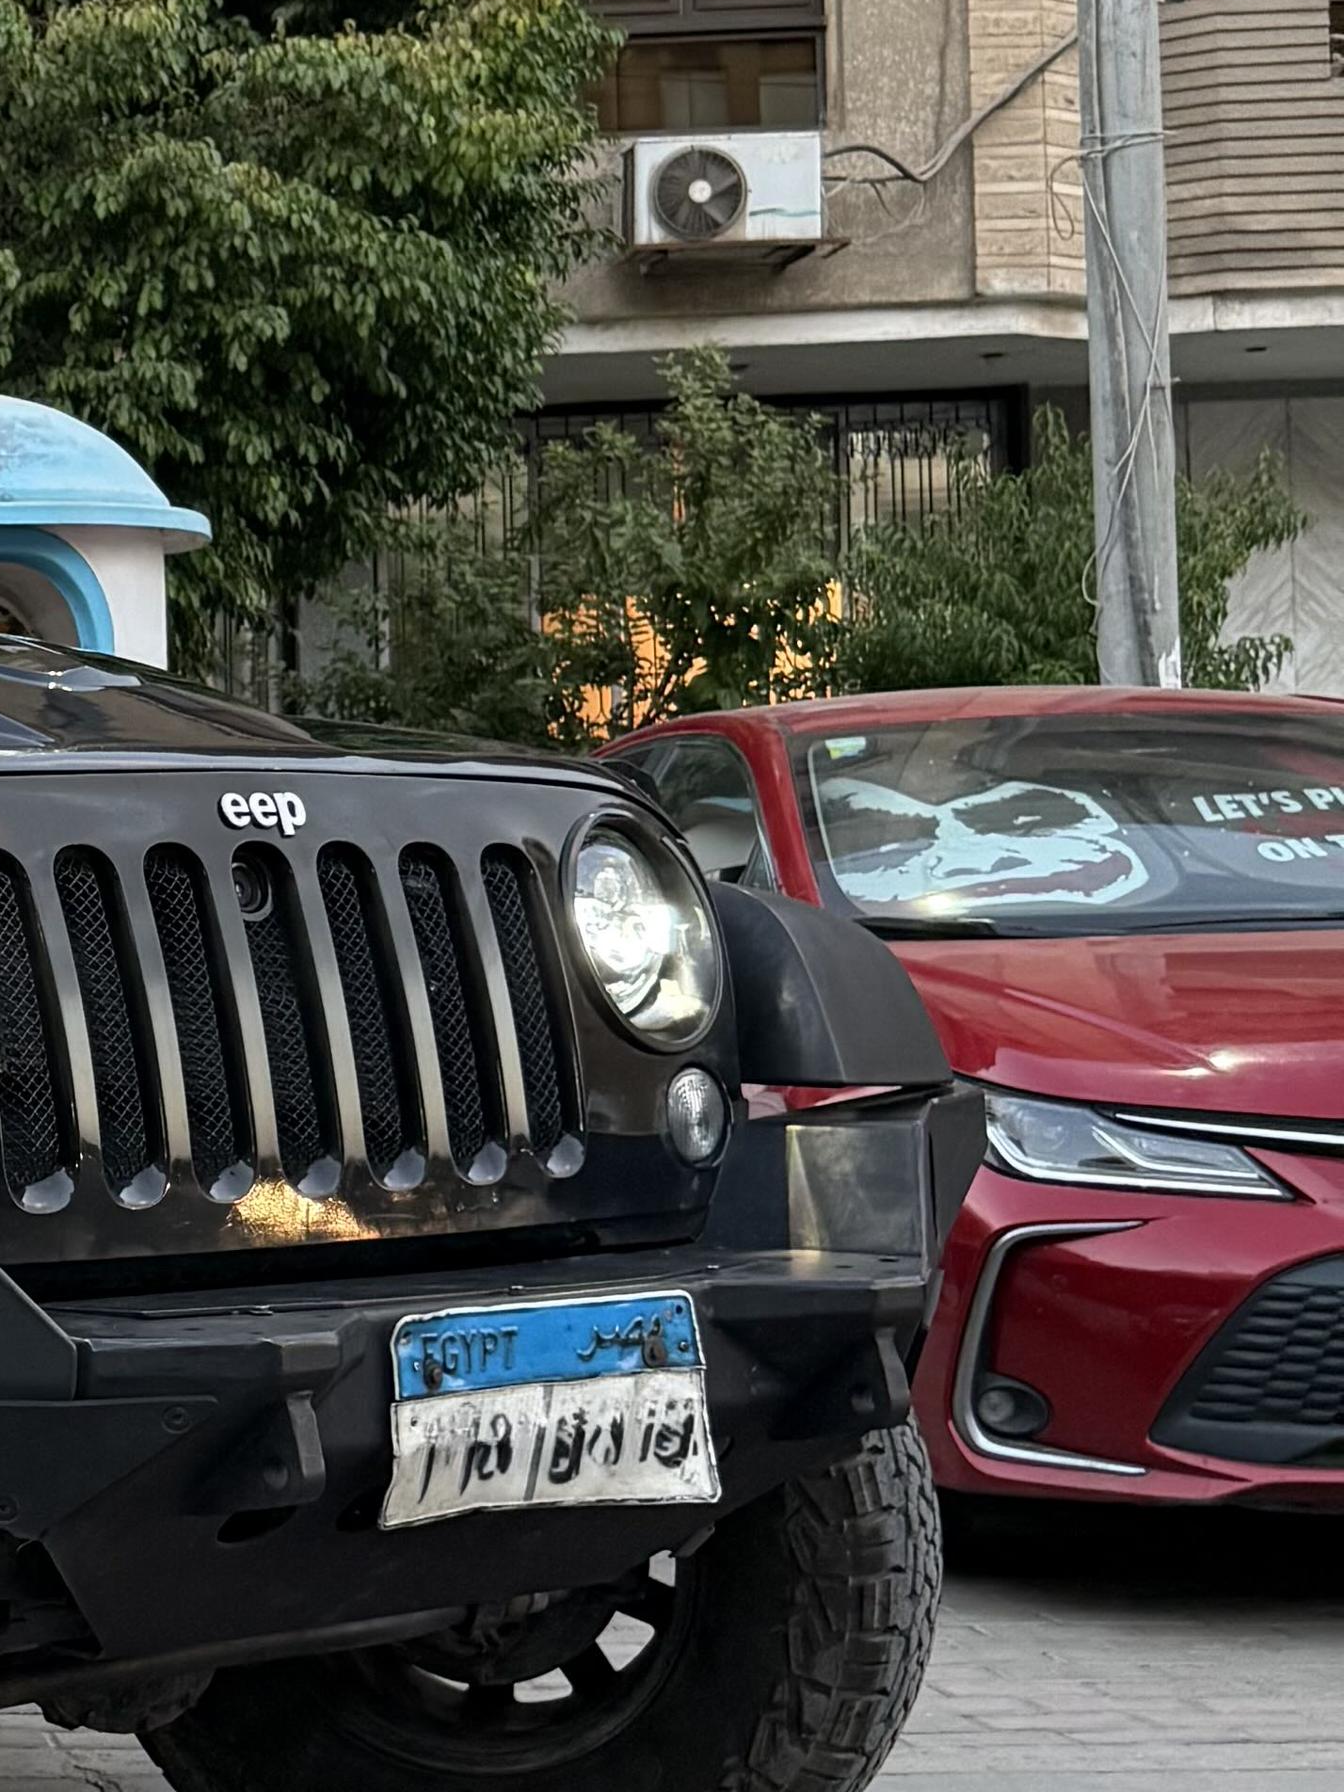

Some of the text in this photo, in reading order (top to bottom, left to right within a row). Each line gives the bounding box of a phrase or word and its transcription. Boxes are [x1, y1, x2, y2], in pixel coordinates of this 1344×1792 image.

[1192, 791, 1303, 822] LET'S
[1257, 837, 1328, 862] ON
[420, 1325, 519, 1376] EGYPT
[576, 1313, 666, 1362] مصر
